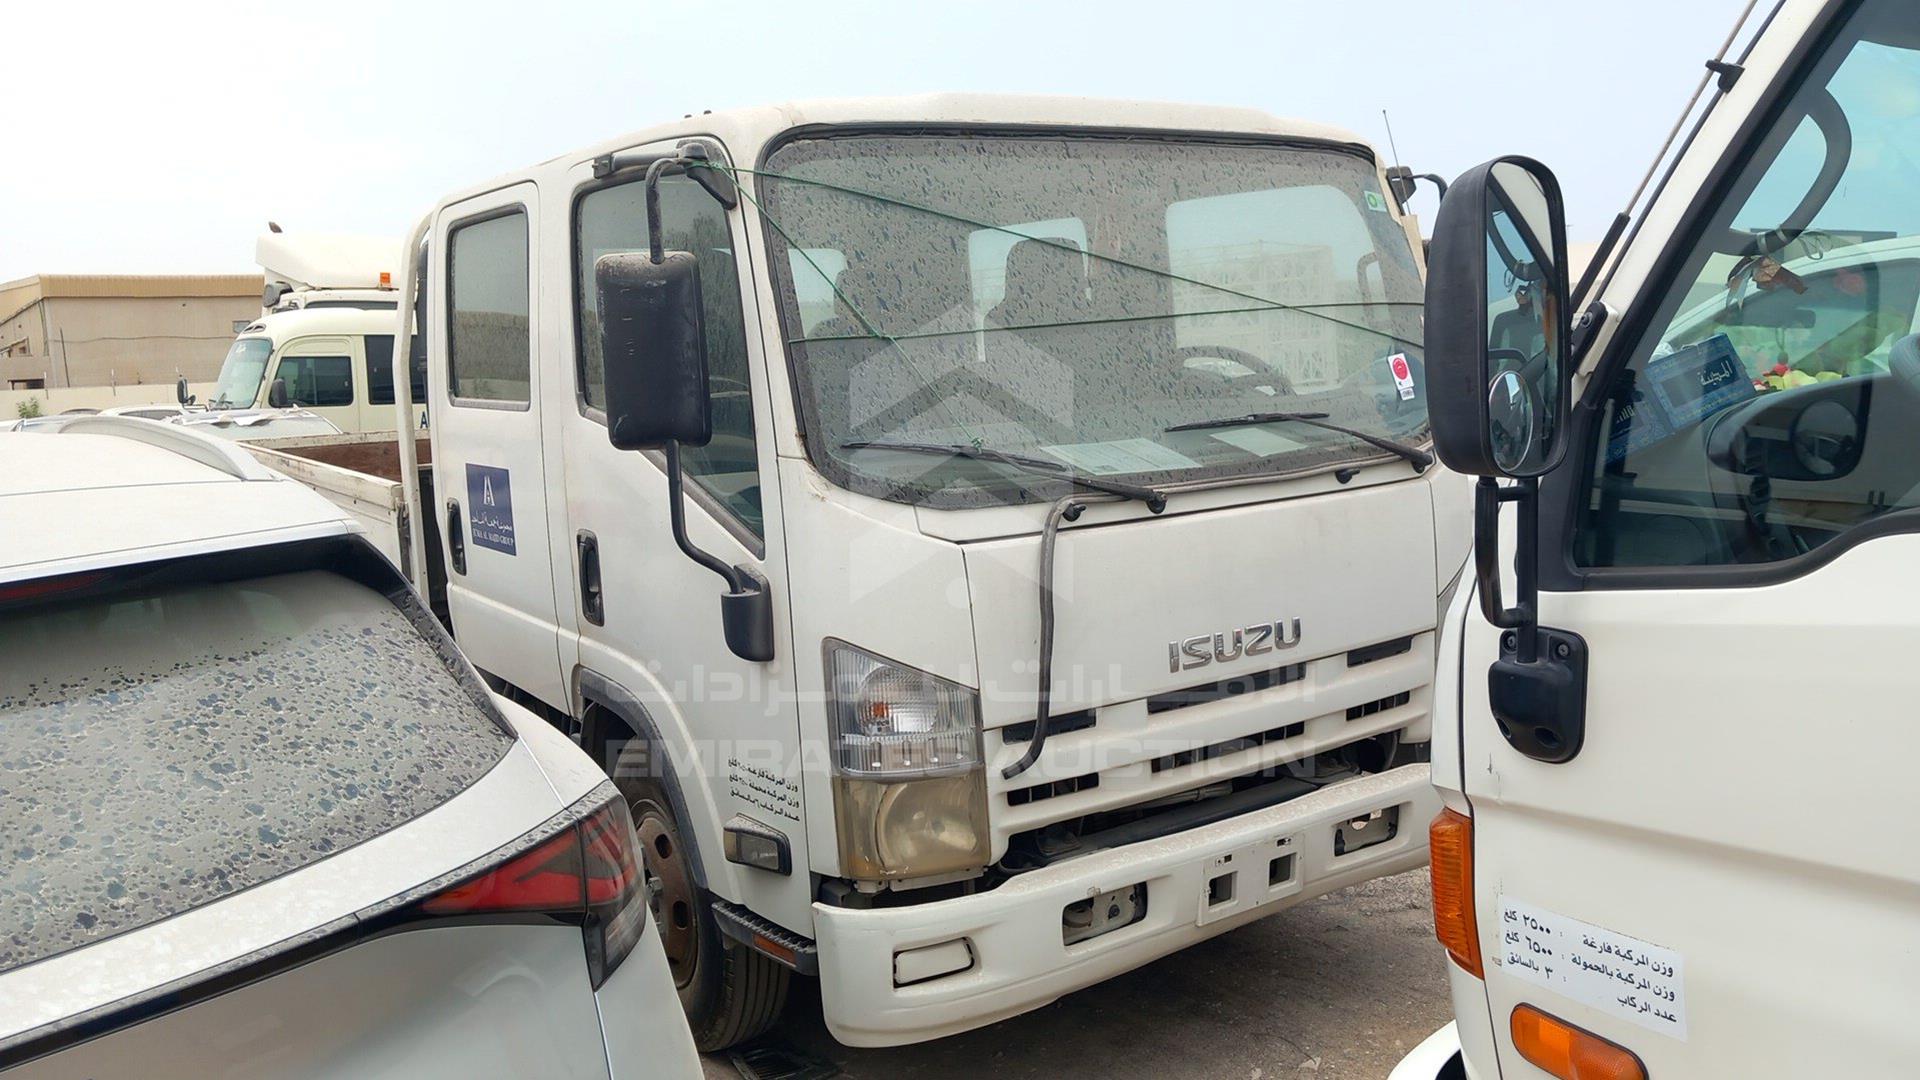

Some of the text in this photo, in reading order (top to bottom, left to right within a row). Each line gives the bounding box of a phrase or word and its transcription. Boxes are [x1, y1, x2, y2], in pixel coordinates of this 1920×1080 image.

[1168, 616, 1301, 674] ISUZU
[1504, 908, 1517, 923] كلغ
[1523, 914, 1551, 934] ٢٥٠٠
[1505, 930, 1520, 944] كلغ
[1525, 936, 1552, 955] ٦٥٠٠
[1583, 934, 1612, 954] فارغة
[1507, 952, 1540, 974] بالسائق
[1614, 945, 1649, 966] المركبة
[1571, 953, 1614, 979] بالحمولة
[1651, 961, 1674, 977] وزن
[1616, 968, 1651, 989] المركبة
[1653, 985, 1675, 1002] وزن
[1617, 995, 1651, 1013] الركاب
[1654, 1008, 1677, 1022] عدد
